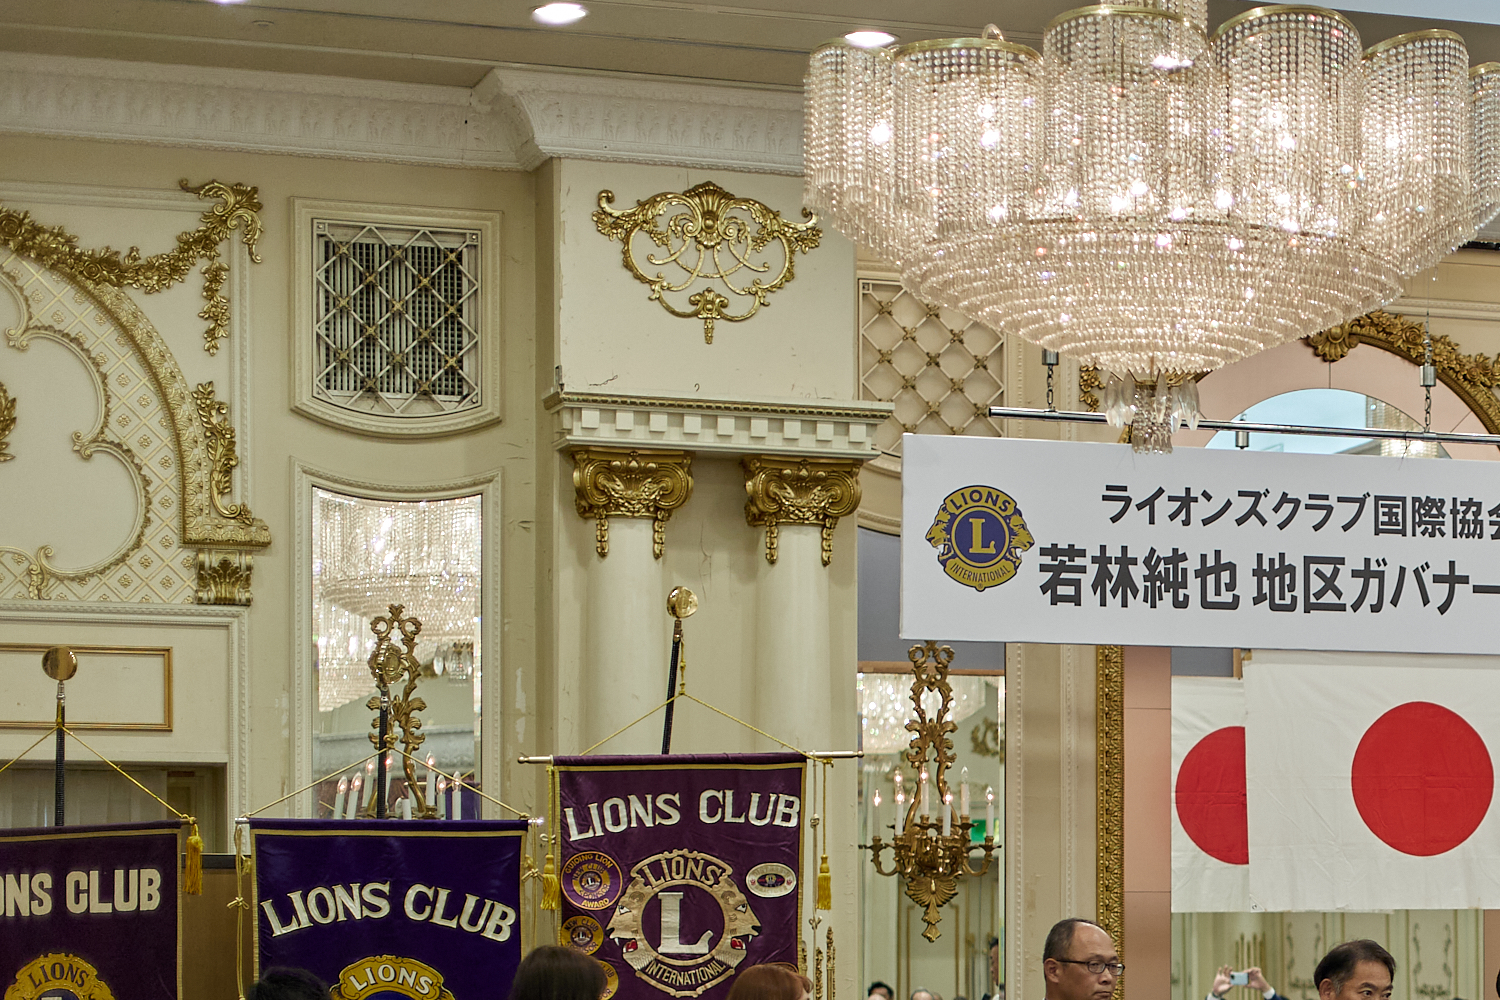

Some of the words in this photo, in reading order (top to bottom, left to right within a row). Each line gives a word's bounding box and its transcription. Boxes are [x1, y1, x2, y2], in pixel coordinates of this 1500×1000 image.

[949, 489, 1012, 513] LIONS
[968, 517, 997, 554] L
[949, 562, 1011, 583] INTERNATIONAL
[563, 791, 681, 841] LIONS
[699, 788, 801, 828] CLUB
[565, 853, 594, 874] GUIDING
[595, 853, 613, 869] LION
[642, 856, 723, 888] LIONS
[65, 868, 161, 914] CLUB
[581, 897, 610, 909] AWARD
[260, 880, 391, 938] LIONS
[403, 883, 517, 943] CLUB
[657, 891, 714, 954] L
[28, 962, 90, 990] LIONS
[348, 964, 434, 995] LIONS
[645, 959, 727, 987] INTERNATIONAL
